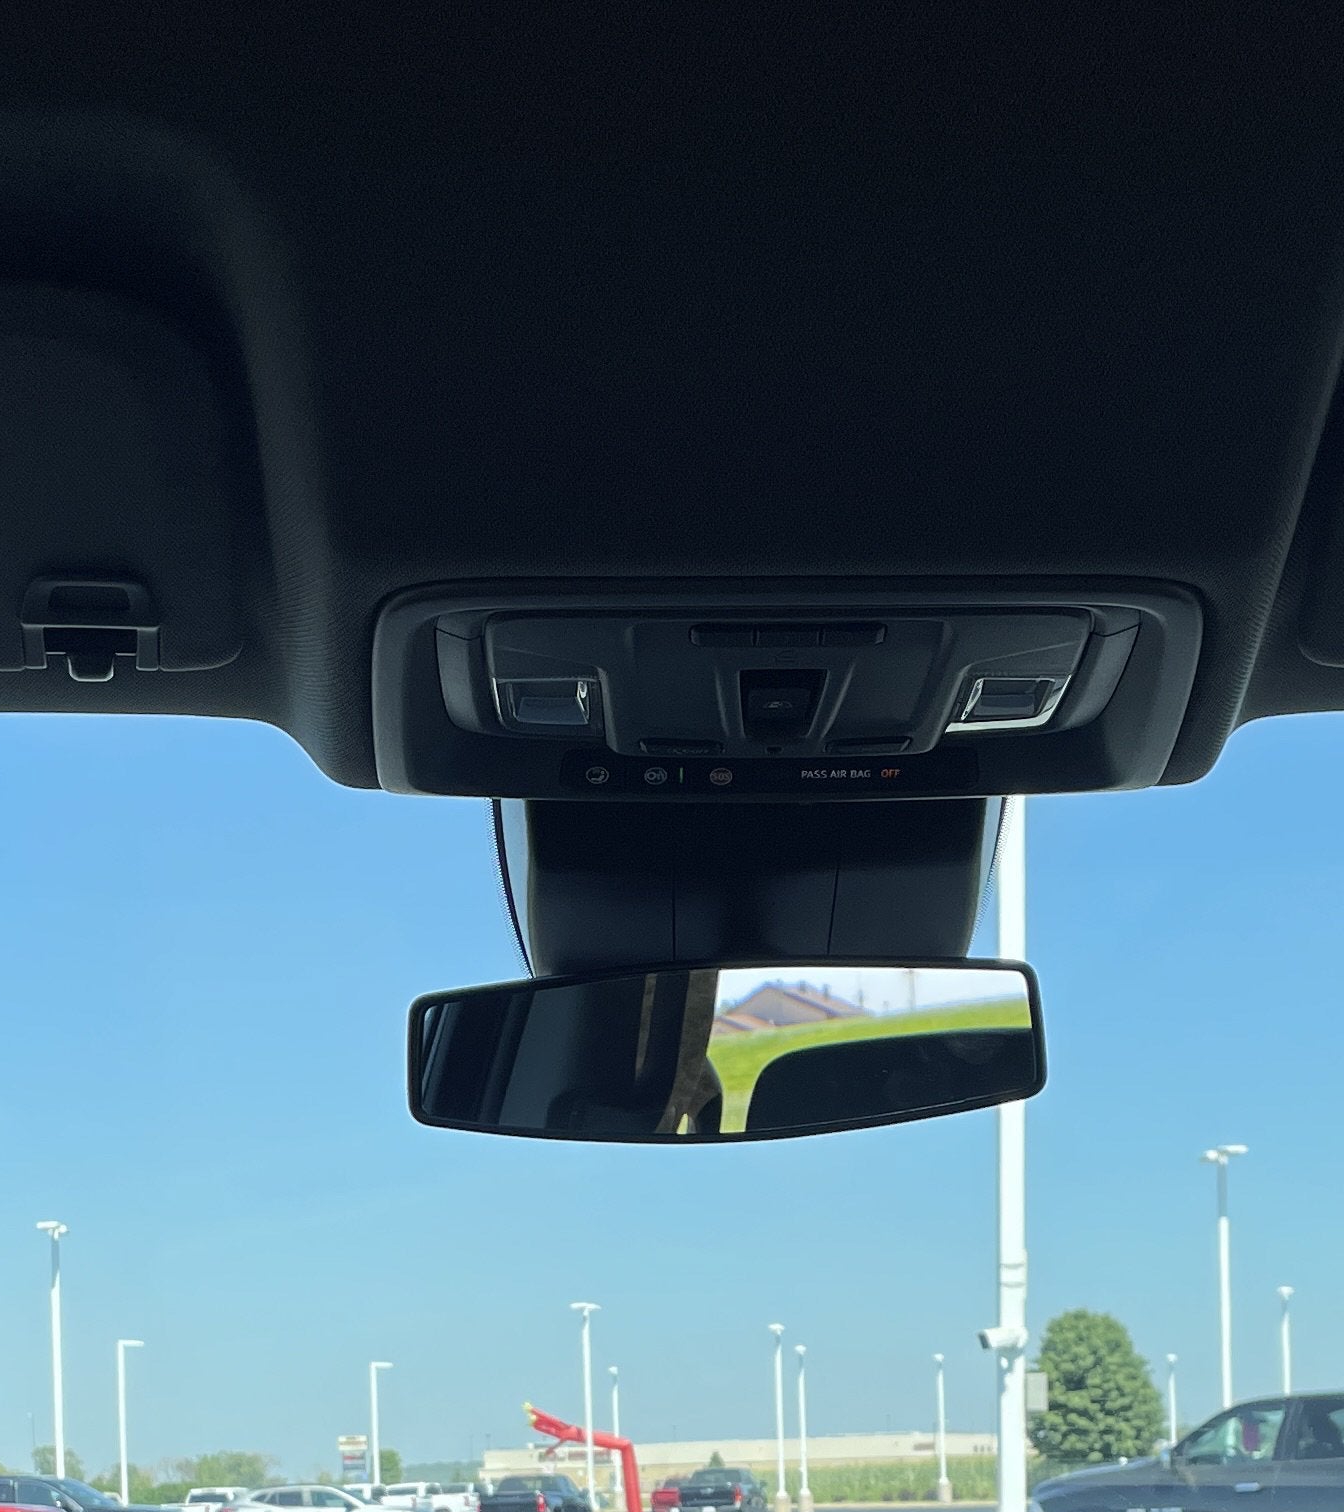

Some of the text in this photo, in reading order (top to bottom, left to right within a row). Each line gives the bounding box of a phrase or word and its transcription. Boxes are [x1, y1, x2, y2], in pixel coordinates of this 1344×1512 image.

[801, 768, 901, 780] PASS AIR BAG OFF
